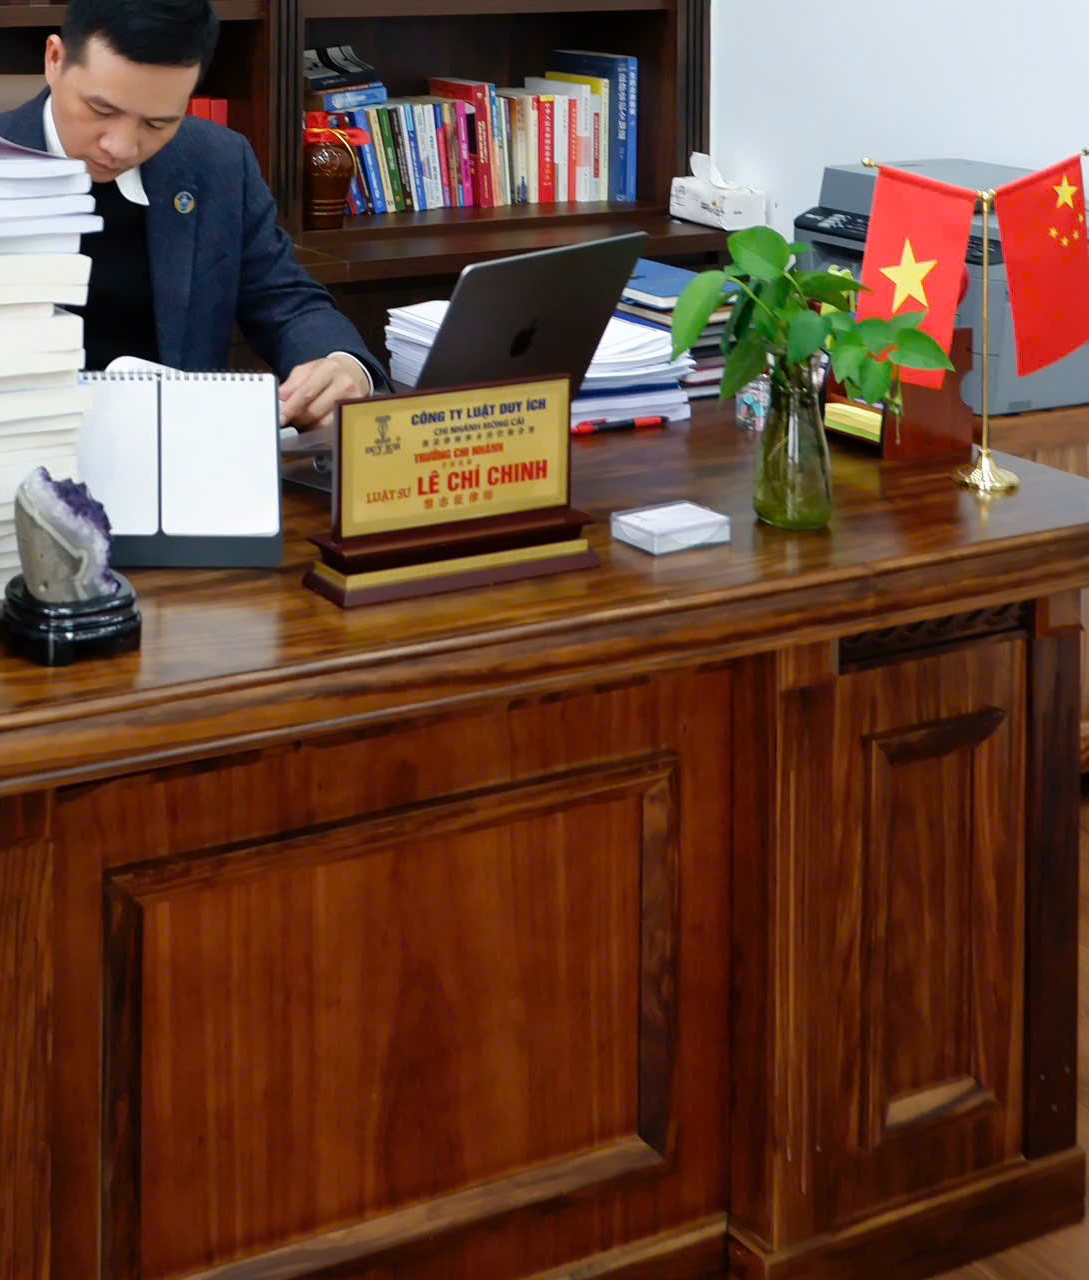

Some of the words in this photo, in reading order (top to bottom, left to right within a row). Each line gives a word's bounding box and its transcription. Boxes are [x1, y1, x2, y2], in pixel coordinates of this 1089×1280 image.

[411, 410, 446, 426] CÔNG
[449, 408, 463, 421] TY
[466, 404, 496, 420] LUẬT
[525, 397, 546, 410] ÍCH
[453, 446, 470, 459] CHI
[416, 470, 440, 497] LÊ
[446, 465, 480, 491] CHÍ
[486, 459, 548, 487] CHINH
[366, 488, 396, 504] LUẬT
[397, 486, 411, 500] SƯ
